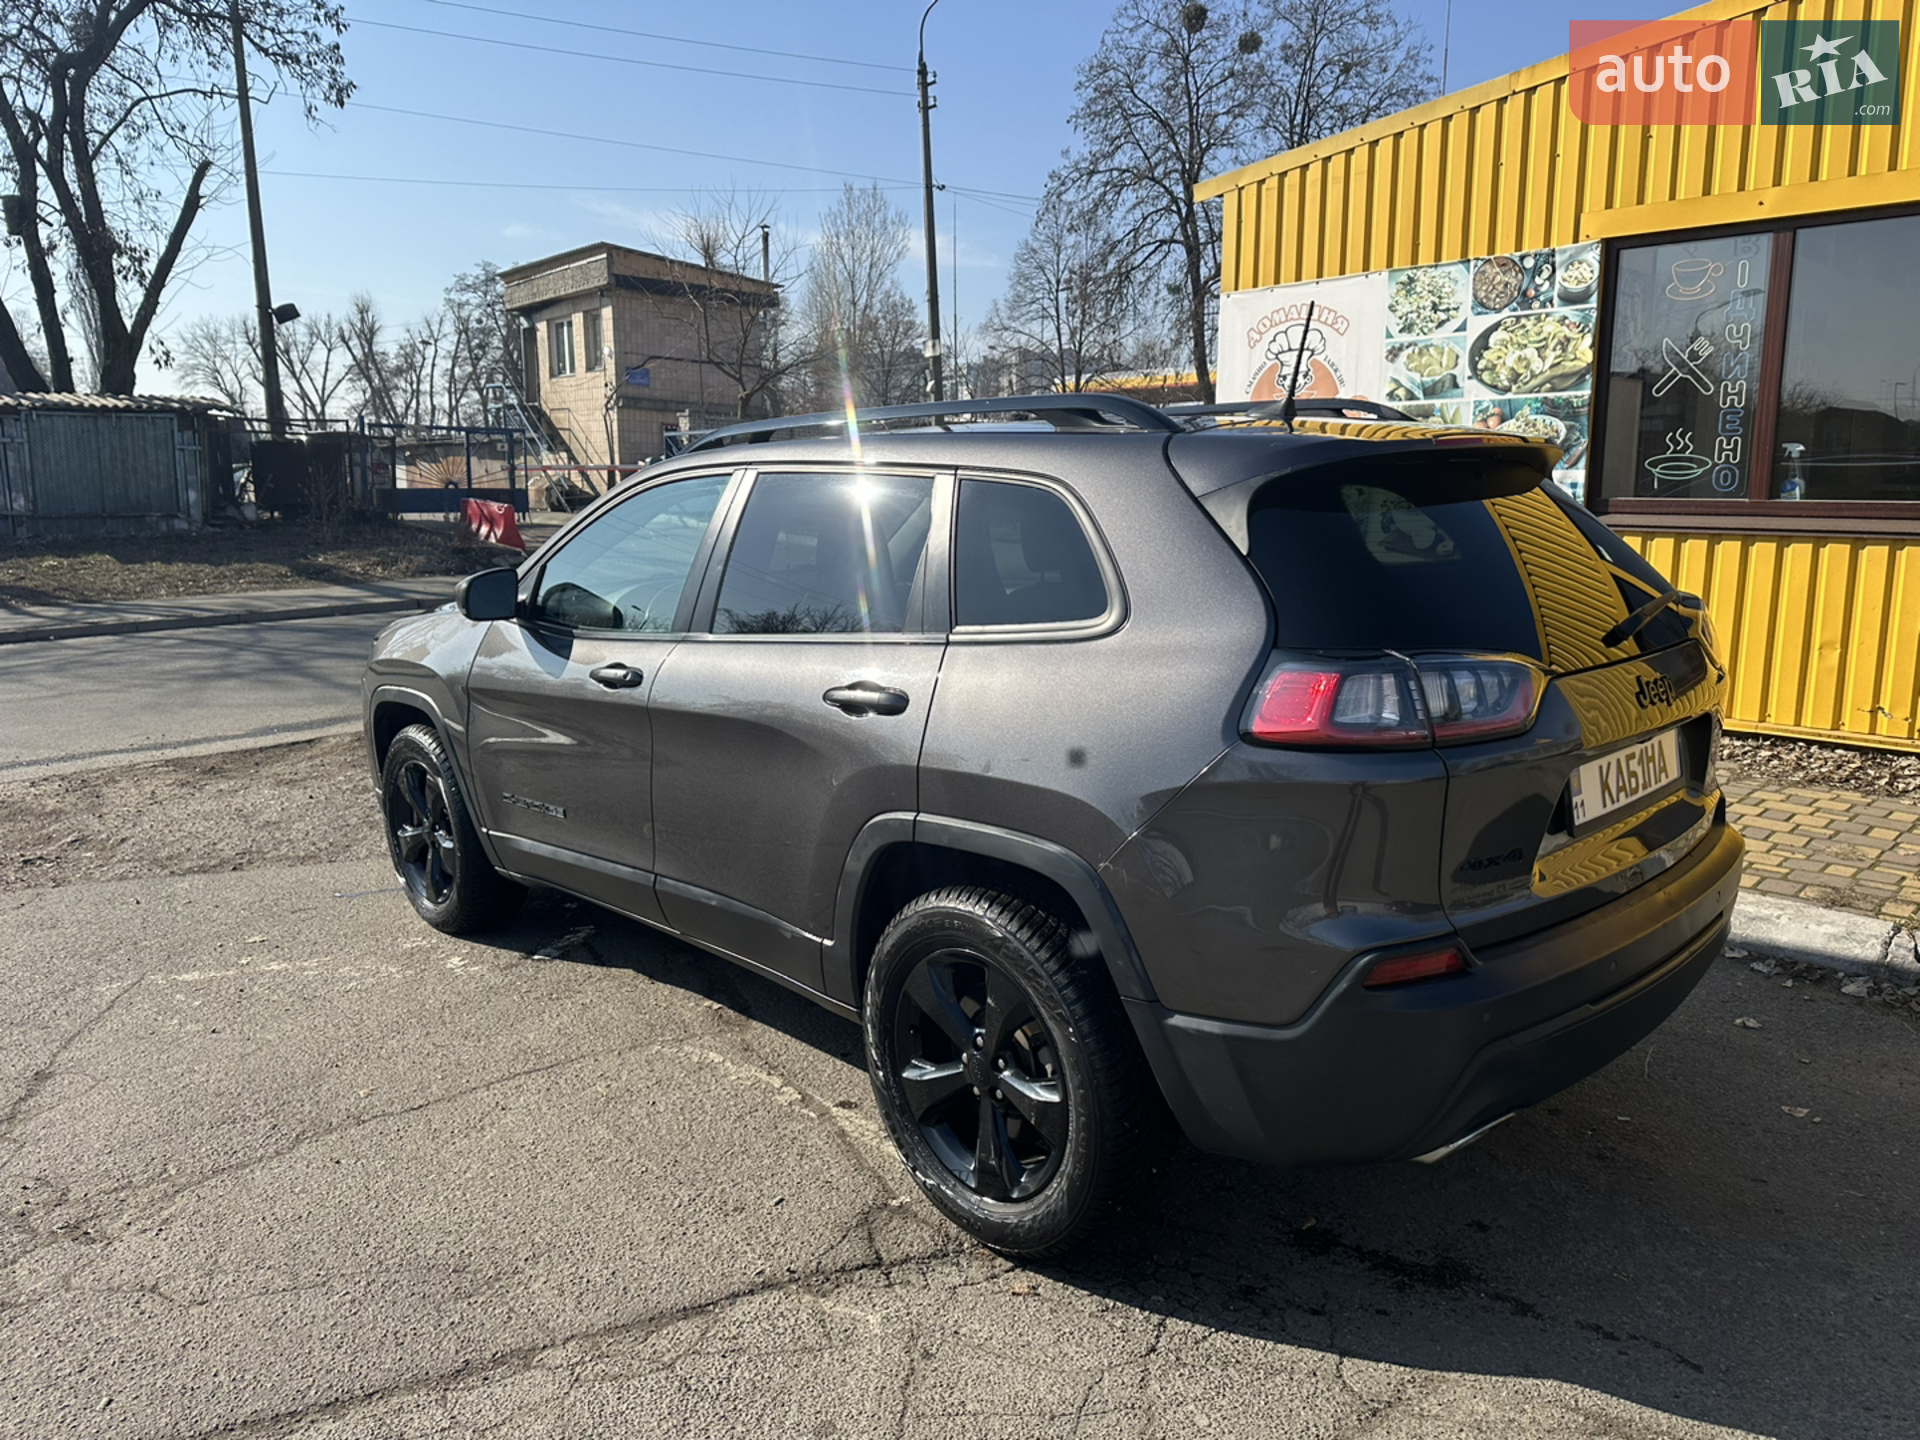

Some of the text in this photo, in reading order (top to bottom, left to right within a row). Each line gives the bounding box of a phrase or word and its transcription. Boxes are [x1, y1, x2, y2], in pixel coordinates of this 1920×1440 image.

[1711, 237, 1760, 492] ВІДЧИНЕНО
[1635, 674, 1675, 709] Jeep
[1574, 799, 1586, 821] 11
